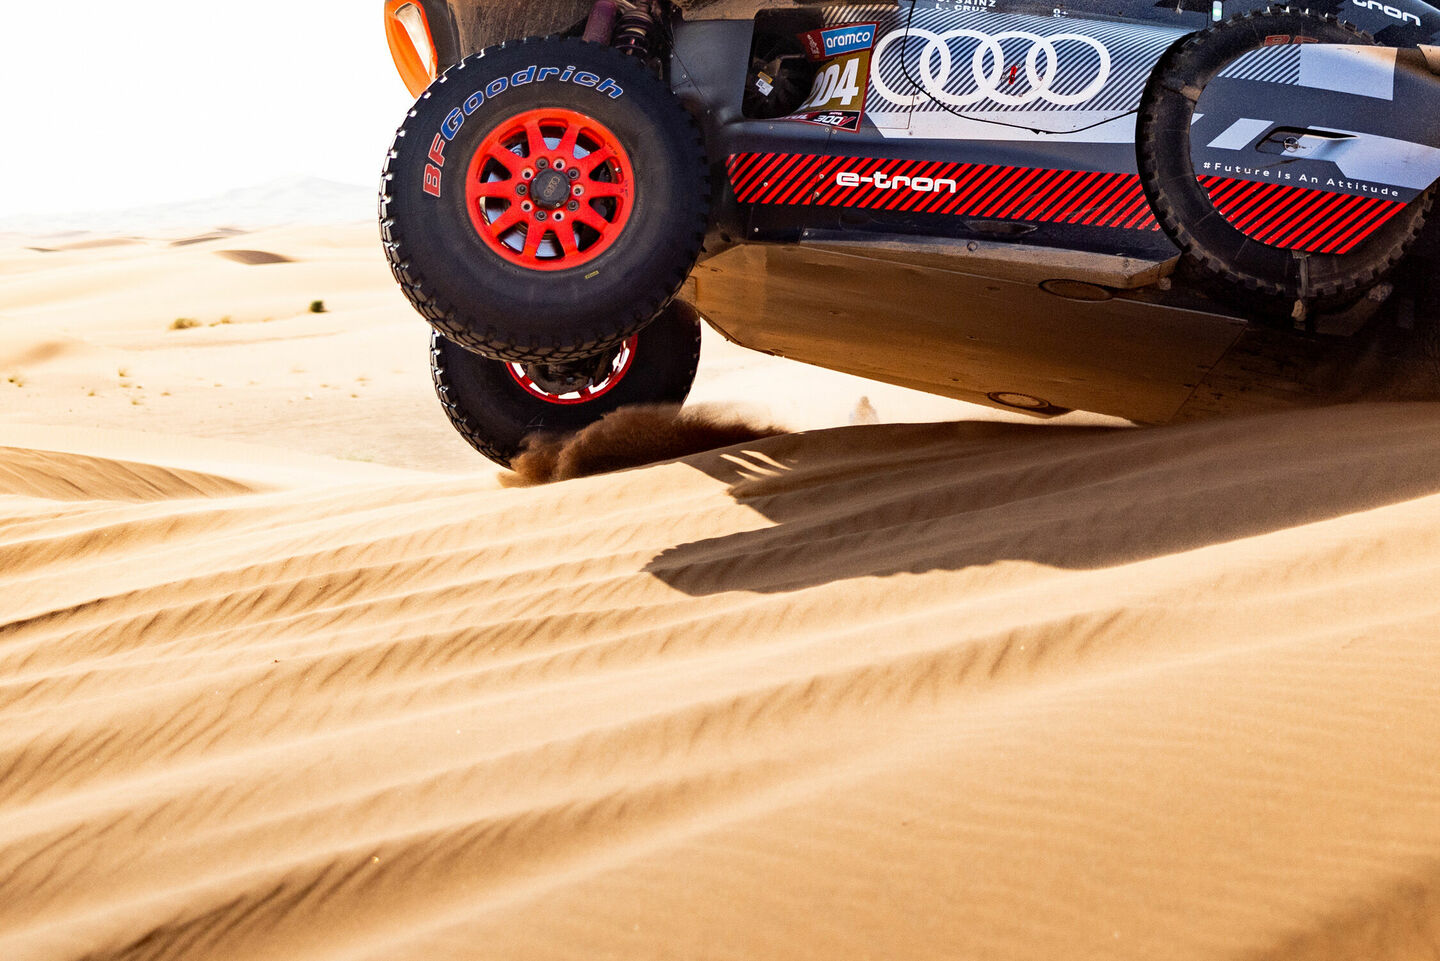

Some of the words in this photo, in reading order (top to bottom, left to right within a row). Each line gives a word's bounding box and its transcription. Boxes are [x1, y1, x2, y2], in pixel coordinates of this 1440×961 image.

[954, 4, 988, 13] CRUZ
[825, 31, 871, 49] aramco
[423, 65, 624, 198] BFGoodrich
[836, 171, 957, 194] e-tron
[1203, 161, 1270, 177] #Future
[1277, 170, 1292, 180] Is
[1298, 173, 1319, 185] An
[1326, 177, 1400, 198] Attitude
